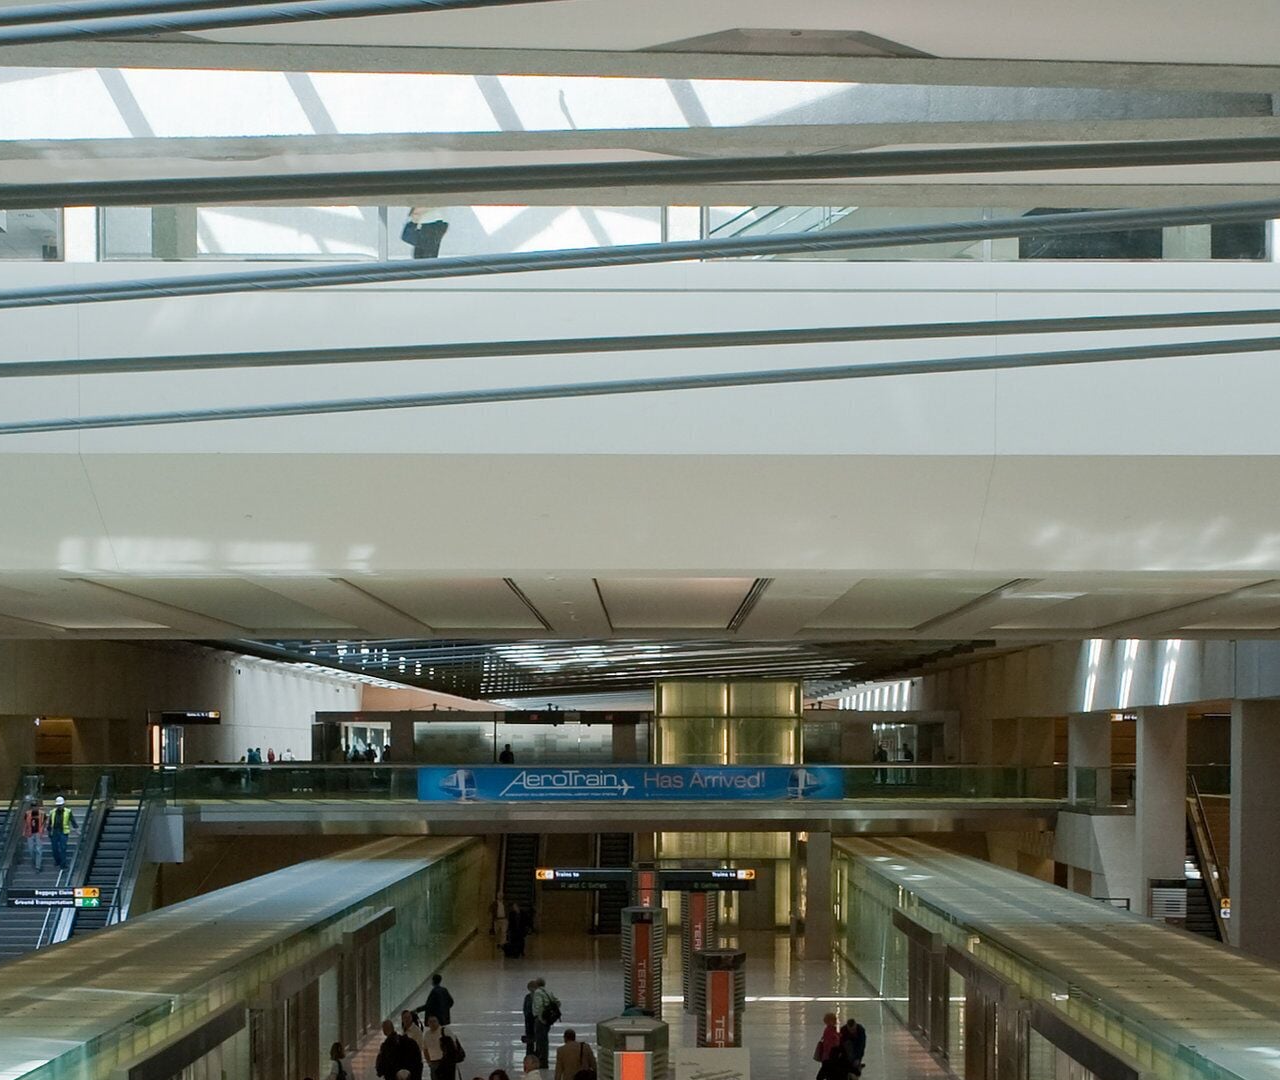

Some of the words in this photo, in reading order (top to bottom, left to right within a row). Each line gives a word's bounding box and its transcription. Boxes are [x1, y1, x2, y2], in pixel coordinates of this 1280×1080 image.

[499, 770, 619, 796] AeroTrain
[643, 772, 684, 788] Has
[689, 771, 766, 788] Arrived!
